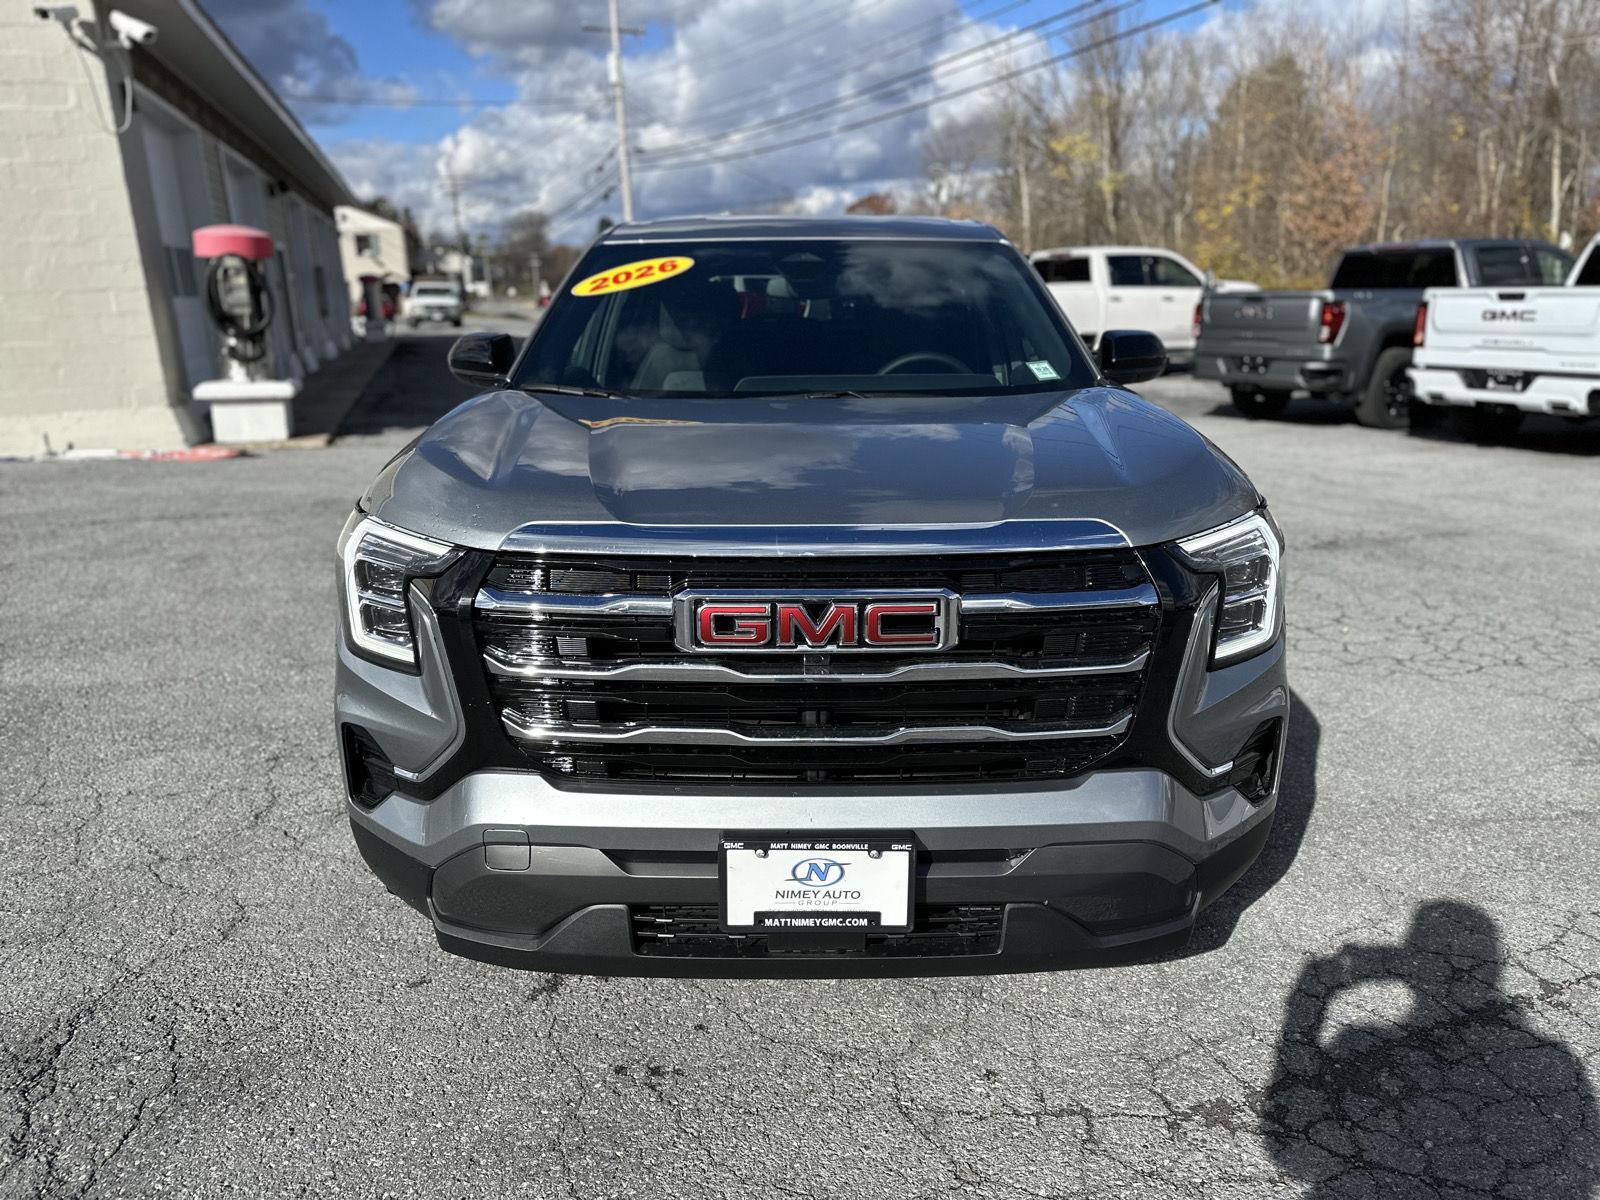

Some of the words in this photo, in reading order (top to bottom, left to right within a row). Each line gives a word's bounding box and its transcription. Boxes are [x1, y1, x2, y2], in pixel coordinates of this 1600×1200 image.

[590, 260, 679, 292] 2026
[696, 602, 940, 646] GMC
[775, 890, 821, 899] NIMEY
[824, 890, 861, 899] AUTO
[764, 918, 868, 927] MATTNIMEYGMC.COM
